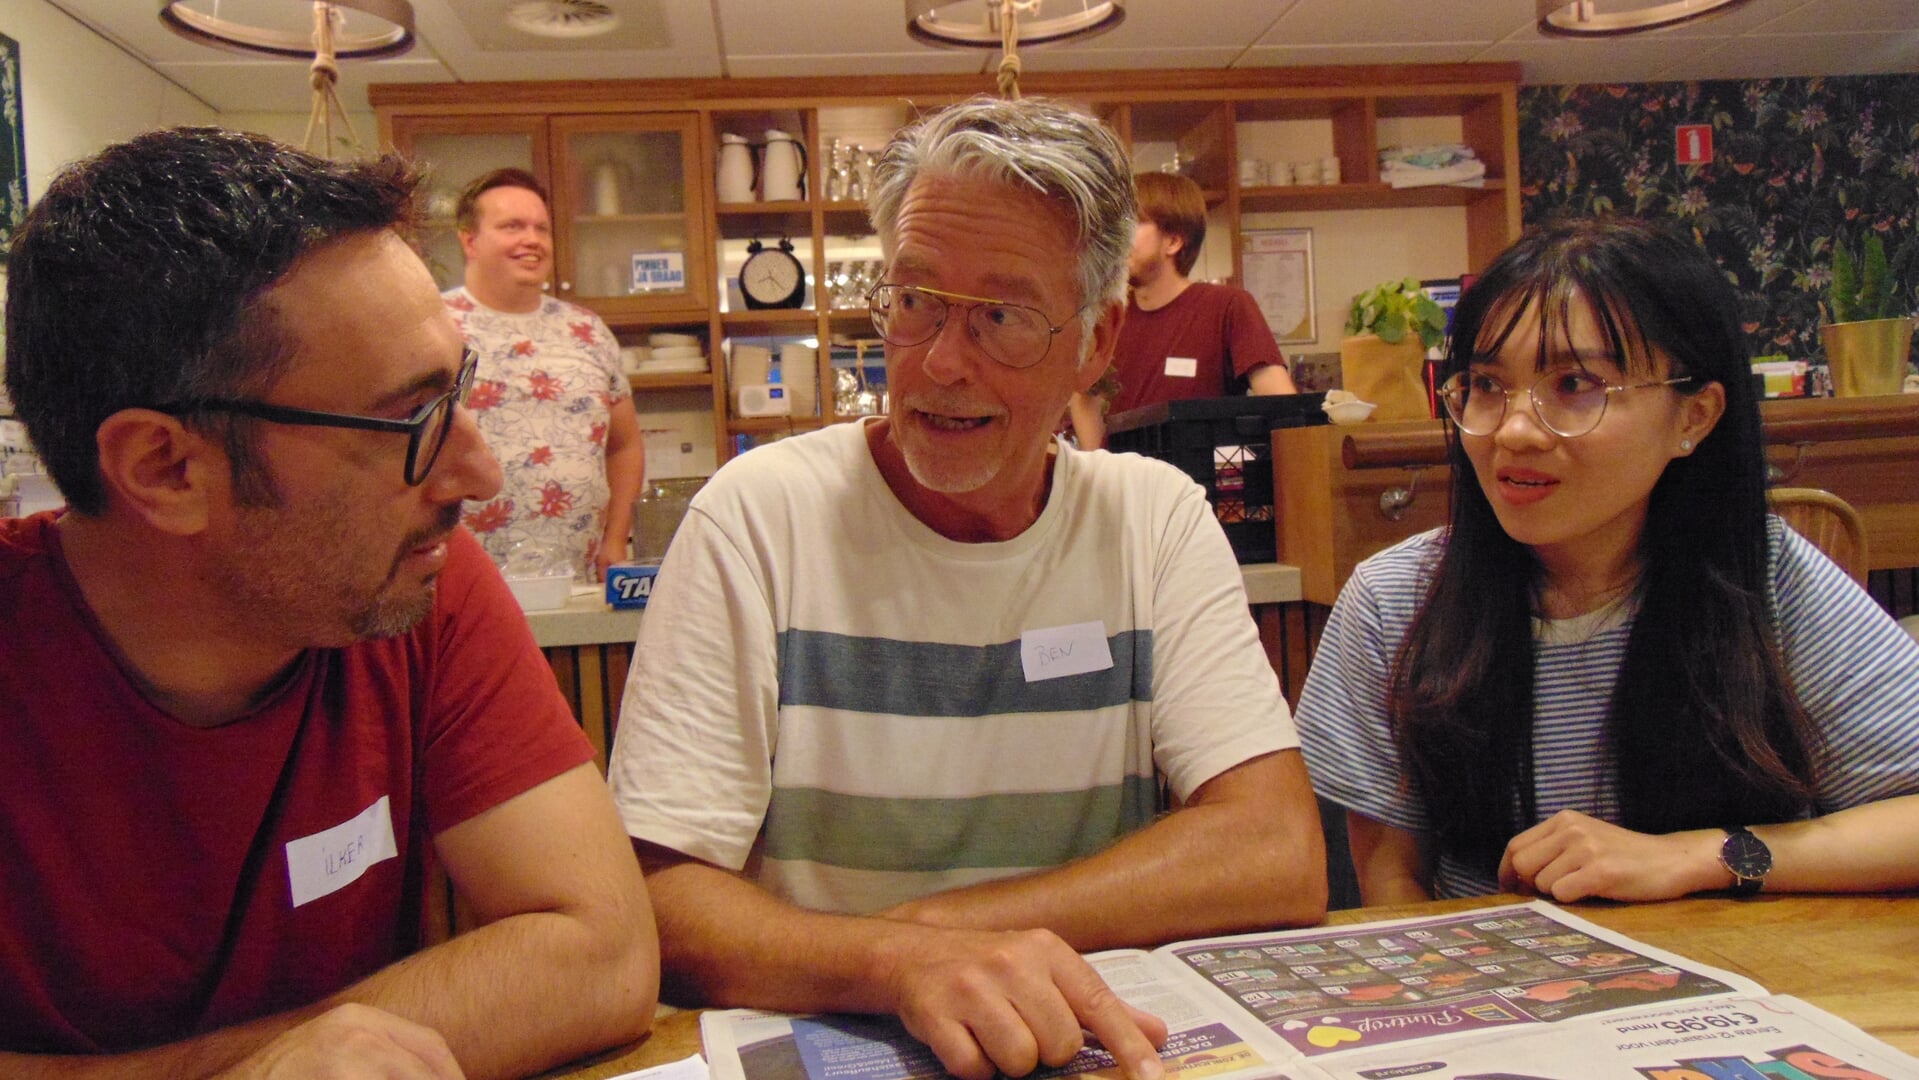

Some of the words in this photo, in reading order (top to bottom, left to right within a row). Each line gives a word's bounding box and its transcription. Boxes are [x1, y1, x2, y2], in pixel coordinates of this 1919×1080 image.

[620, 576, 652, 599] TA
[1033, 639, 1075, 666] BEN
[1357, 1009, 1463, 1032] Flintrop
[1158, 1041, 1213, 1058] DAGBE
